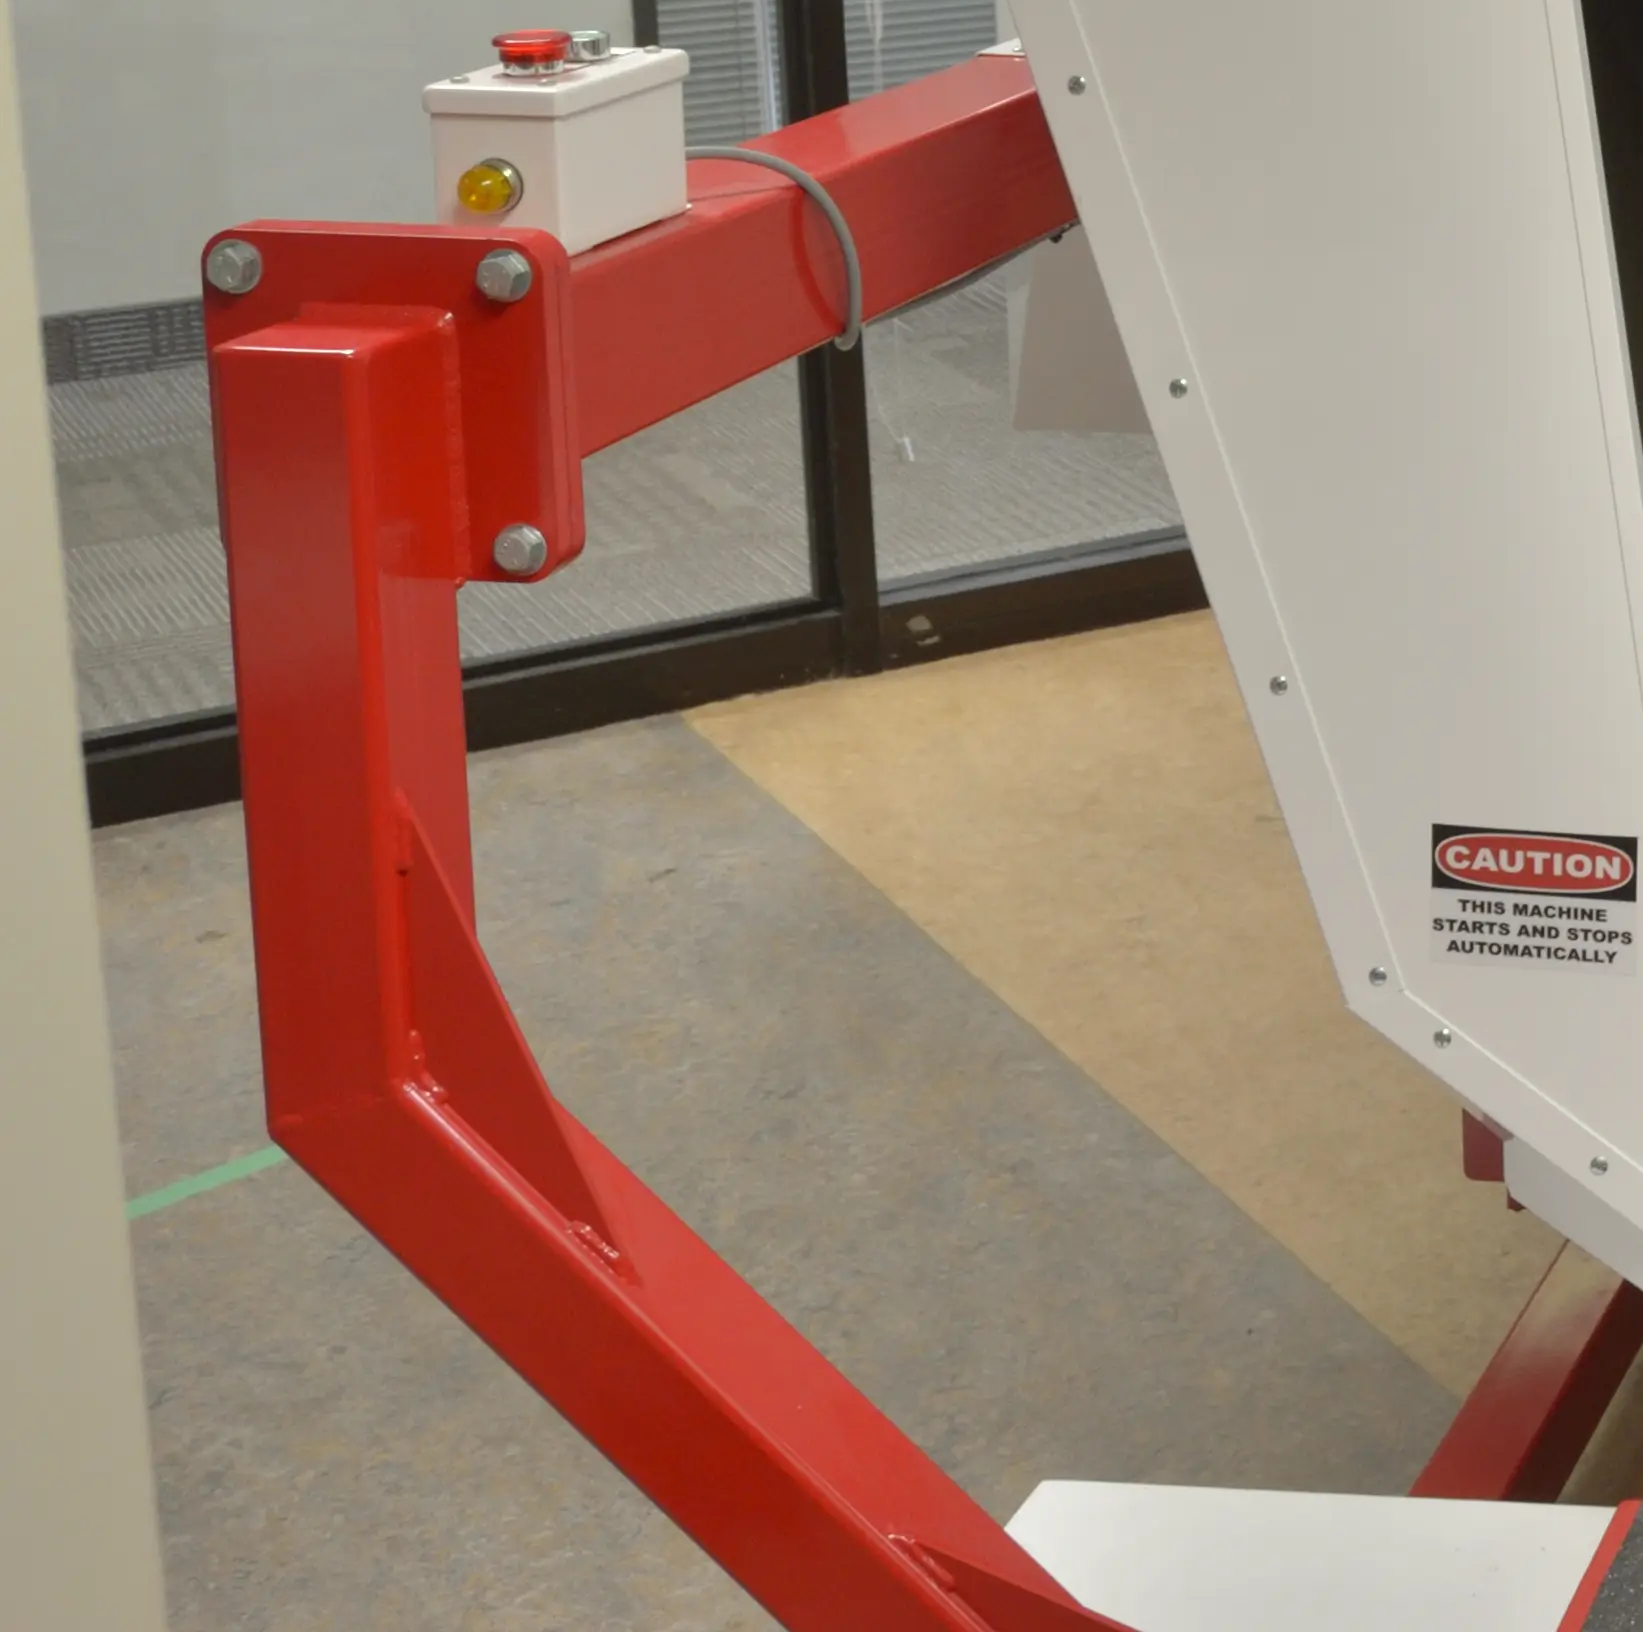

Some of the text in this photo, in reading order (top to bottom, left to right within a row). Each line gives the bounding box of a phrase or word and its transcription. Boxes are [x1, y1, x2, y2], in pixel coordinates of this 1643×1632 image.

[1445, 845, 1621, 880] CAUTION
[1458, 898, 1608, 922] THIS MACHINE
[1432, 918, 1633, 945] STARTS AND STOPS
[1446, 939, 1618, 964] AUTOMATICALLY
